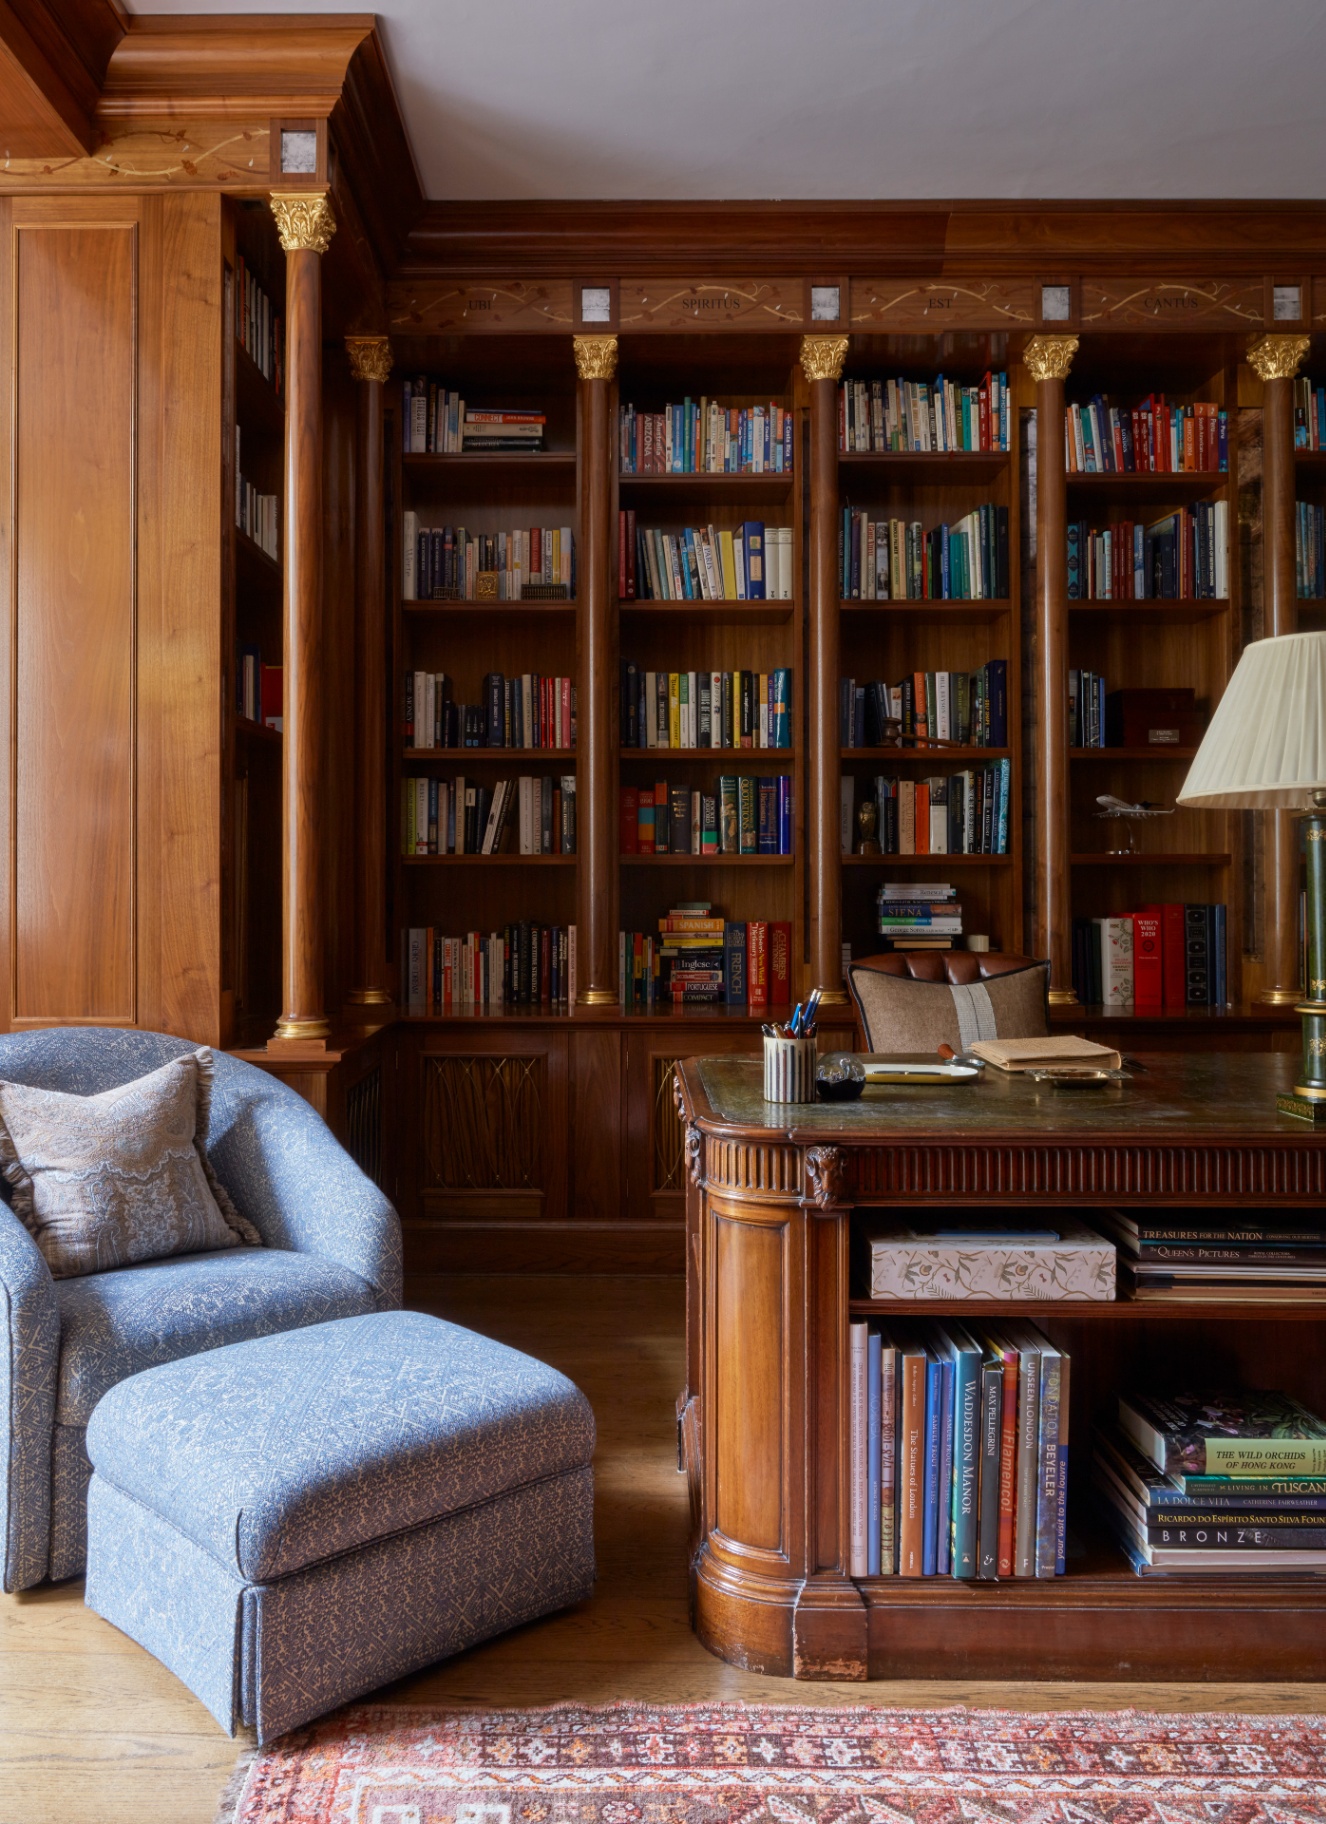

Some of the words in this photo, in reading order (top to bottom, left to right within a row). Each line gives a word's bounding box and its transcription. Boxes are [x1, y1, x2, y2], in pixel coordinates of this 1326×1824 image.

[469, 300, 491, 310] UBI
[682, 298, 740, 309] SPIRITUS
[929, 298, 952, 309] EST
[1144, 297, 1198, 308] CANTUS
[645, 415, 653, 456] ARIZONA
[740, 779, 750, 830] QUOTATIONS
[888, 908, 922, 917] SIENA
[679, 921, 714, 931] SPANISH
[778, 933, 787, 980] CHAMBERS
[681, 959, 711, 972] Inglese
[731, 952, 742, 995] FRENCH
[687, 984, 718, 993] PORTUGUESE
[1143, 1230, 1198, 1239] TREASURES
[1227, 1232, 1263, 1240] NATION
[1157, 1246, 1194, 1258] QUEEN'S
[1198, 1248, 1240, 1258] PICTURES
[1026, 1362, 1036, 1401] UNSEEN
[988, 1386, 997, 1405] MAX
[1046, 1371, 1059, 1439] FONDATION
[963, 1380, 976, 1461] WADDESDON
[1025, 1404, 1035, 1449] LONDON
[910, 1429, 919, 1445] The
[987, 1407, 996, 1456] PELLEGRINI
[910, 1447, 918, 1476] Statues
[1216, 1450, 1235, 1459] THE
[1238, 1451, 1263, 1460] WILD
[1264, 1451, 1306, 1460] ORCHIDS
[1045, 1443, 1057, 1497] BEYELER
[1225, 1461, 1239, 1469] OF
[1241, 1461, 1267, 1470] HONG
[1269, 1462, 1296, 1470] KONG
[1058, 1461, 1066, 1488] louvre
[909, 1477, 918, 1487] of
[961, 1466, 974, 1515] MANOR
[909, 1488, 918, 1519] London
[1058, 1491, 1066, 1505] the
[1157, 1496, 1169, 1505] LA
[1173, 1497, 1206, 1505] DOLCE
[1208, 1498, 1230, 1506] VITA
[1058, 1507, 1065, 1516] to
[1157, 1514, 1196, 1523] RICARDO
[1197, 1515, 1211, 1523] DO
[1212, 1513, 1249, 1523] ESPÍRITO
[1250, 1514, 1277, 1523] SANTO
[1279, 1515, 1300, 1524] SILVA
[1162, 1530, 1262, 1543] BRONZE
[1057, 1541, 1065, 1560] your
